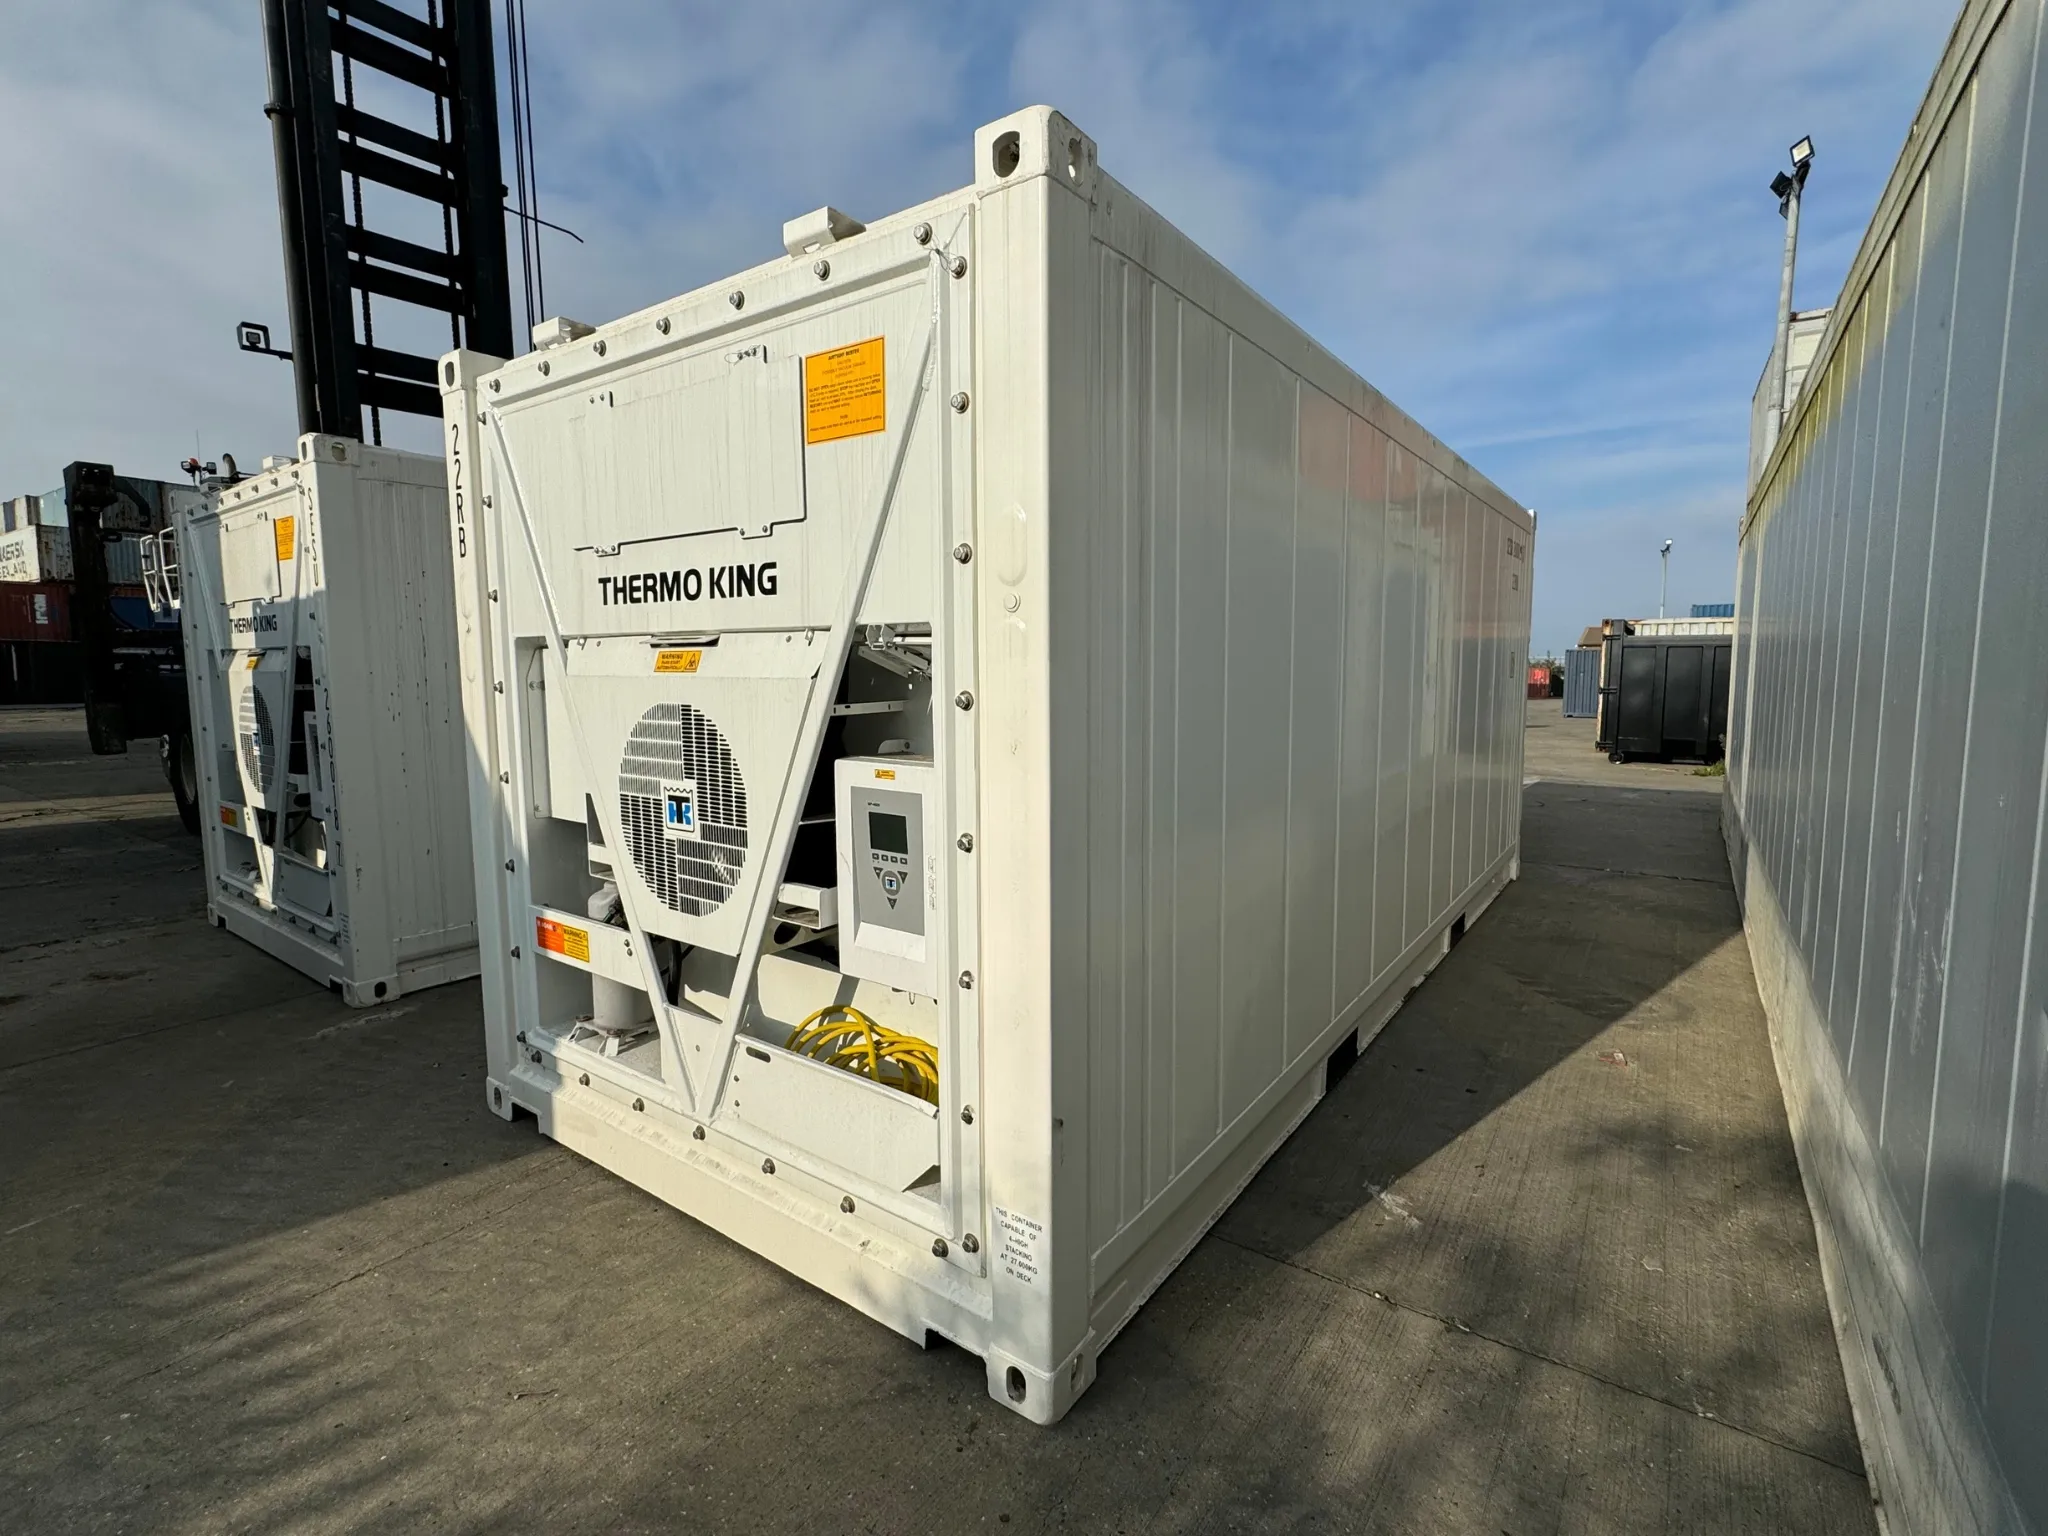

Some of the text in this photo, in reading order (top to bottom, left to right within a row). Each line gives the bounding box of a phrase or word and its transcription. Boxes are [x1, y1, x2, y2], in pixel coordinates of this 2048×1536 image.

[452, 423, 467, 558] 22RB
[307, 487, 319, 587] SESU
[597, 561, 778, 606] THERMO KING
[229, 614, 278, 634] THERMO KING
[996, 1206, 1043, 1233] THIS CONTAINER
[1000, 1220, 1037, 1241] CAPABLE OF
[1000, 1252, 1008, 1261] AT
[1005, 1244, 1033, 1262] STACKING
[1005, 1266, 1032, 1284] ON DECK
